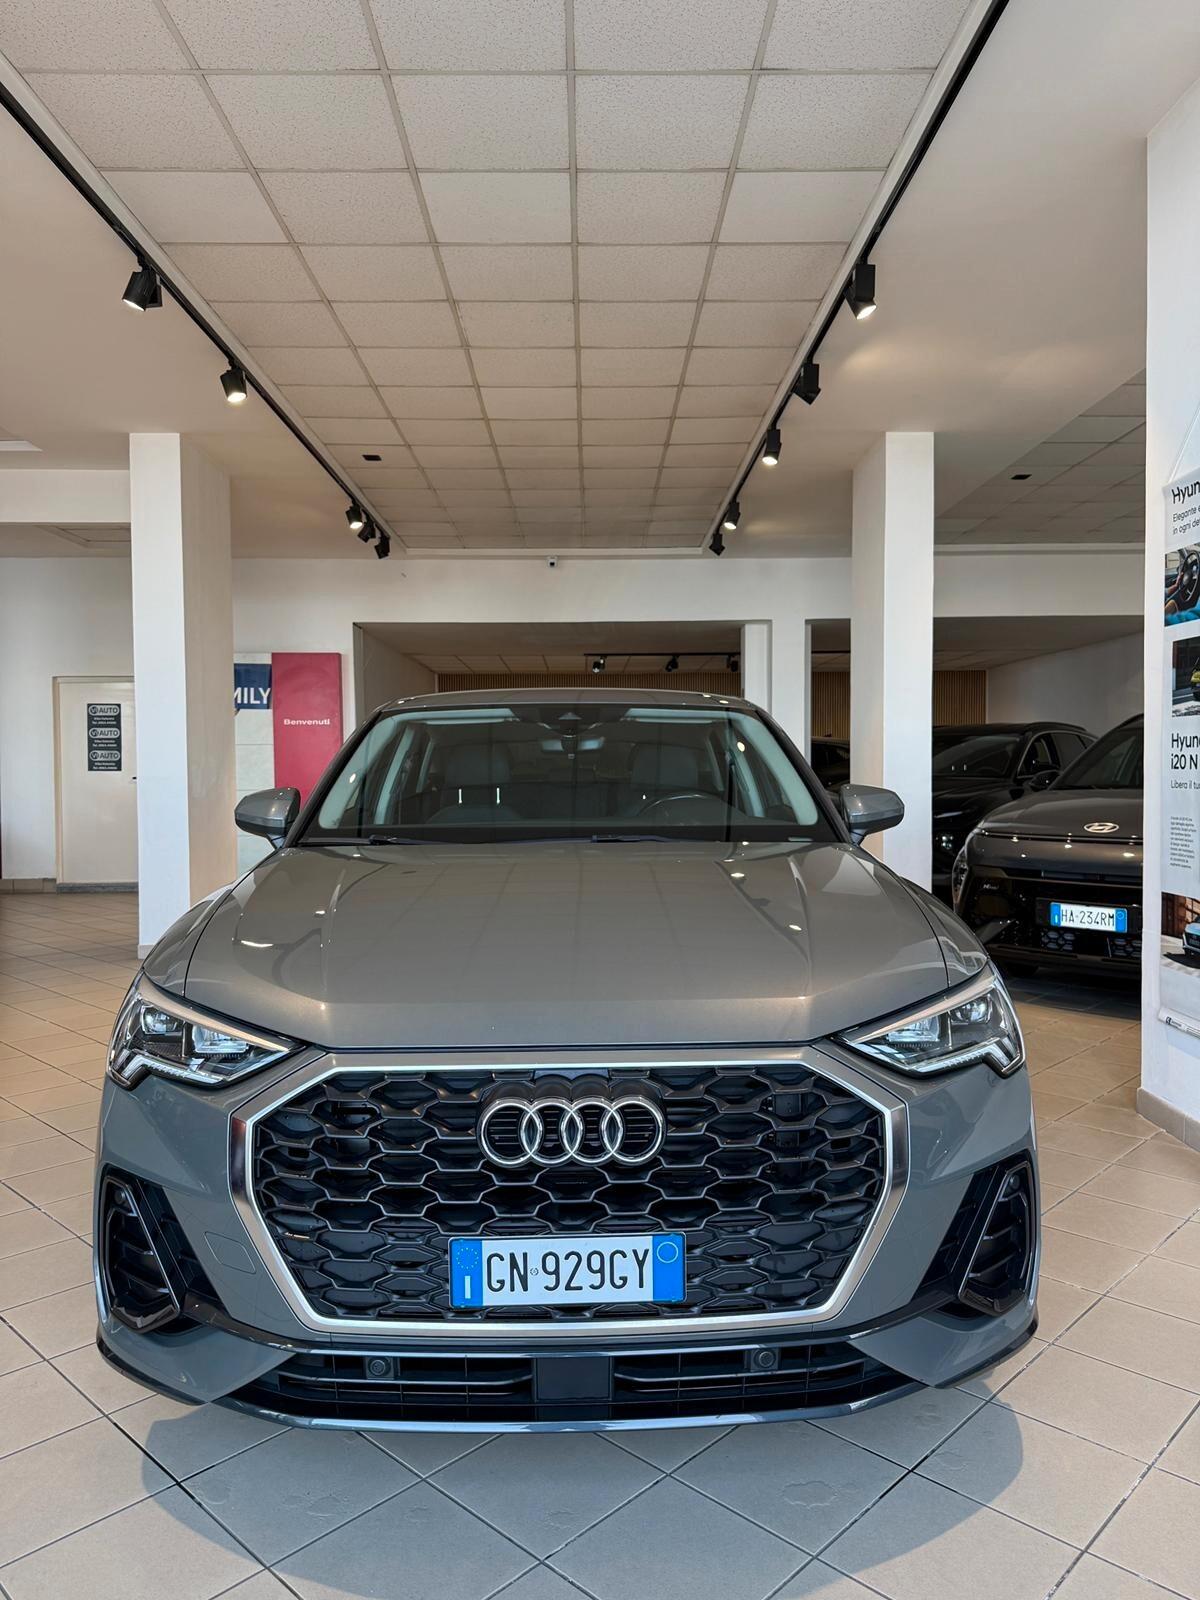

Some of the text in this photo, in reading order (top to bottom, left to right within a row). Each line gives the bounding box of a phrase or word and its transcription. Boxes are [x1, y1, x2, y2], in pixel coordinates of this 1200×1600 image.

[1173, 507, 1197, 523] Elegante
[1179, 520, 1191, 534] ogni
[283, 718, 330, 726] Benvenuti
[1171, 732, 1200, 752] Hyun
[1171, 753, 1198, 770] i20 N
[1171, 779, 1188, 789] Libera
